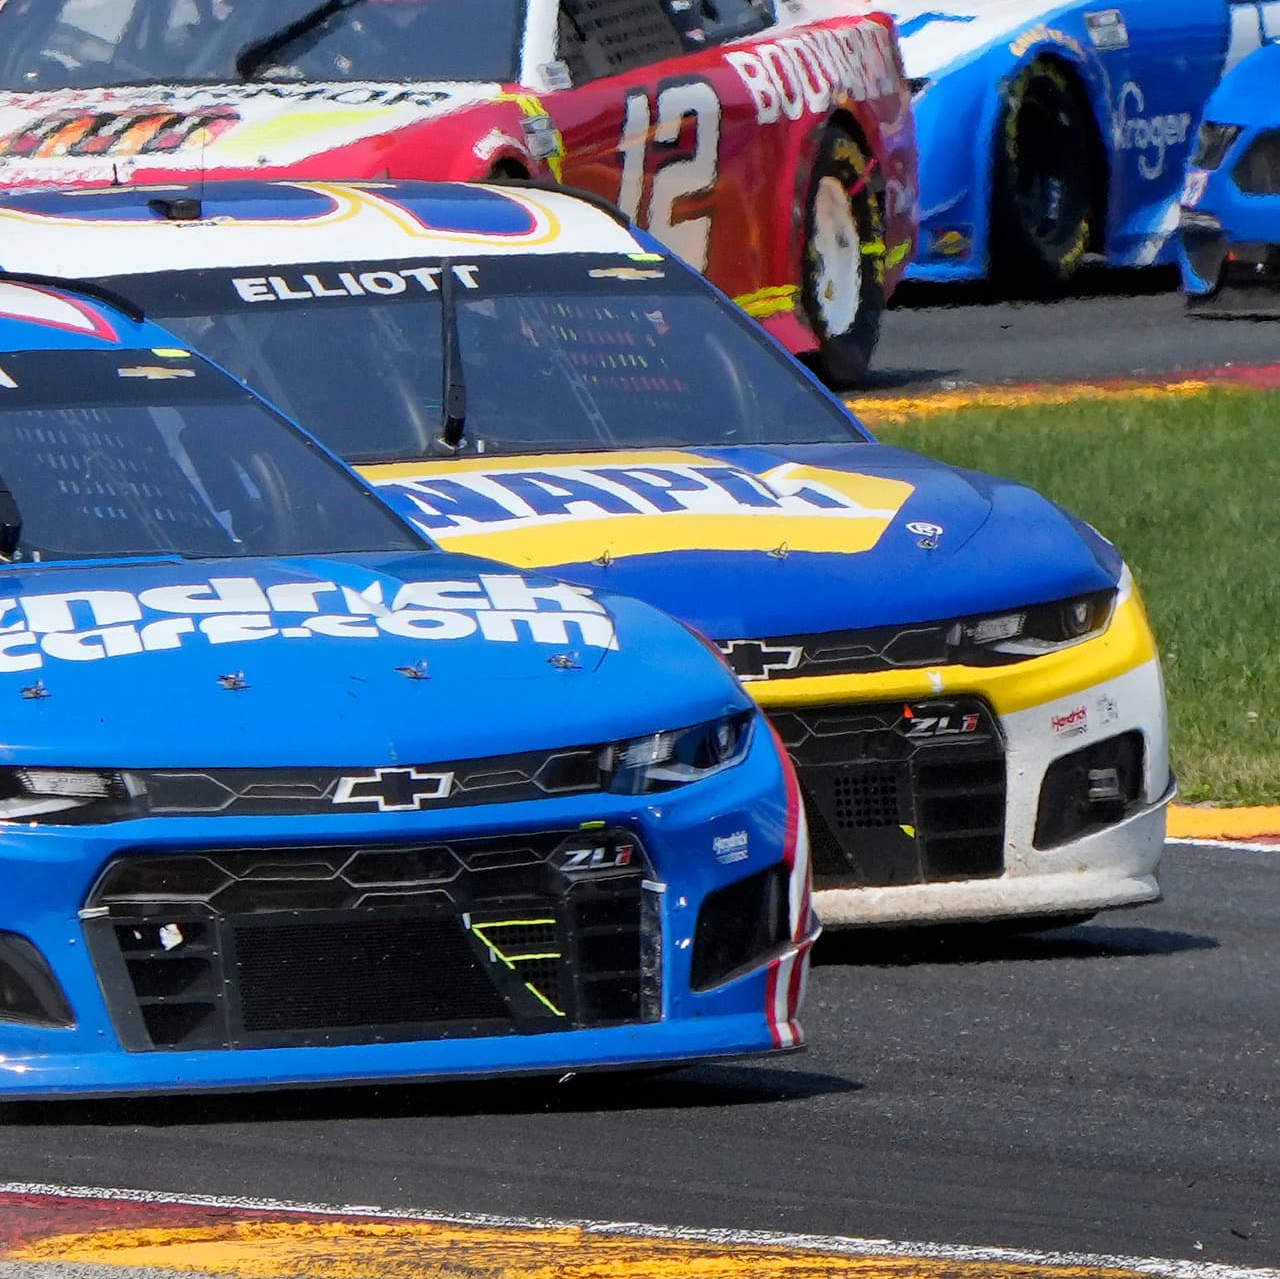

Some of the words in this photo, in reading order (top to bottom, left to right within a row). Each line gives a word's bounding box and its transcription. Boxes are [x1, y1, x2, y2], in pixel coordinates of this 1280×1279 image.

[1111, 81, 1192, 181] Kroger
[617, 81, 720, 277] 12
[232, 264, 481, 303] ELLIOTT
[376, 466, 850, 529] NAPA
[905, 712, 982, 738] ZL1
[558, 844, 635, 872] ZL1
